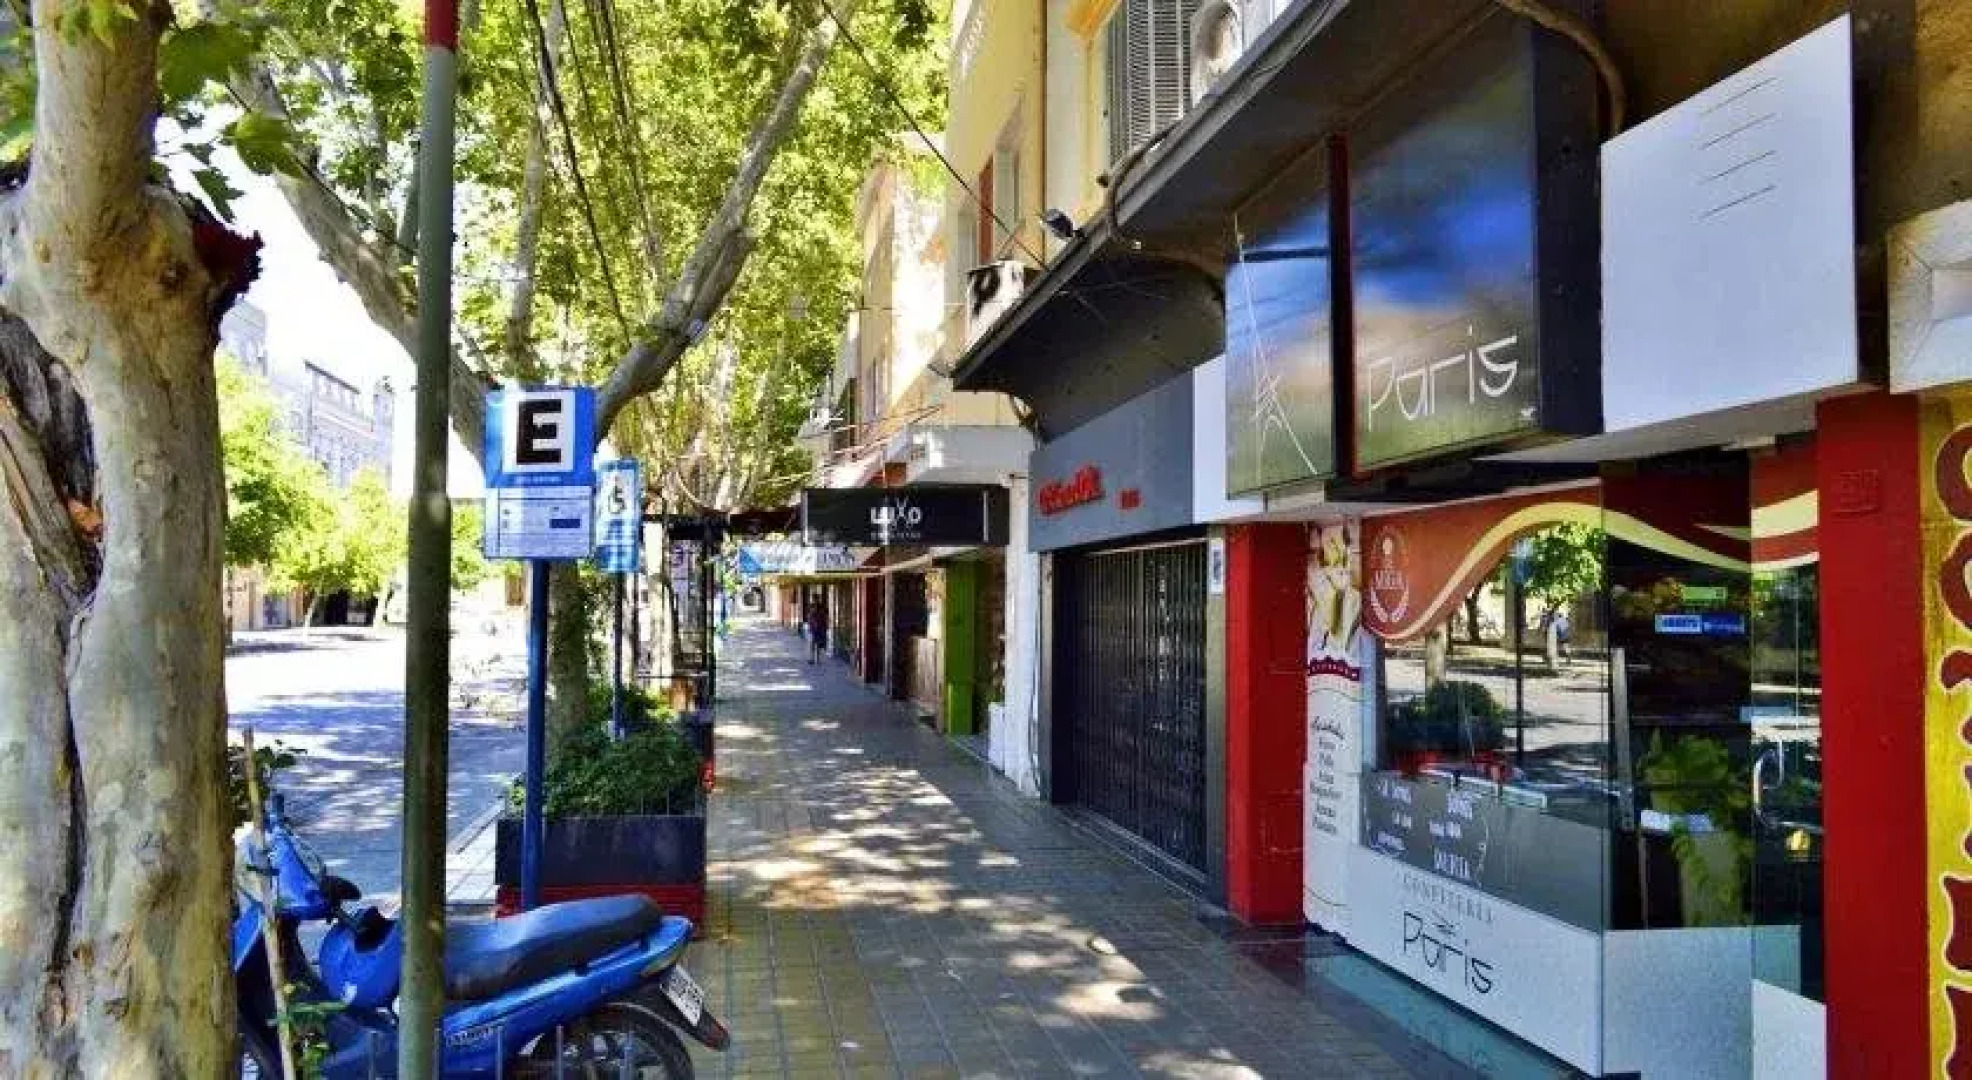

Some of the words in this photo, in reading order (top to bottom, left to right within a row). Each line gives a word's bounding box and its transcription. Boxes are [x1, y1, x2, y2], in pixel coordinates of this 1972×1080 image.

[1367, 323, 1518, 433] Paris
[515, 398, 563, 464] E
[1403, 910, 1494, 994] Paris
